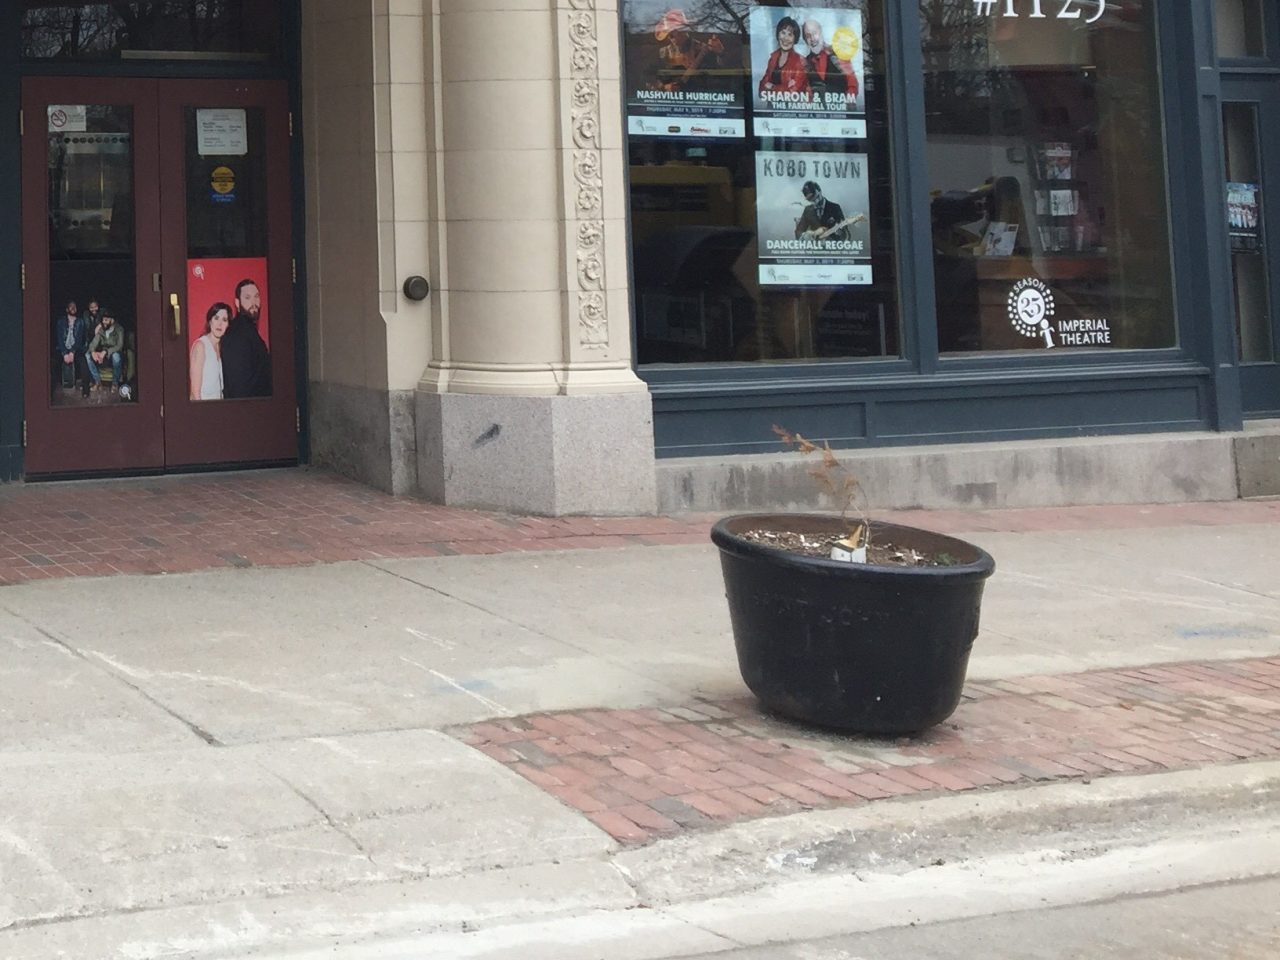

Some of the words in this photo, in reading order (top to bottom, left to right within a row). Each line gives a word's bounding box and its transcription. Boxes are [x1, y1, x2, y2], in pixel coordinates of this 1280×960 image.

[637, 90, 683, 100] NASHVILLE
[686, 91, 735, 102] HURRICANE
[761, 90, 809, 102] SHARON
[813, 92, 821, 103] &
[824, 92, 856, 104] BRAM
[772, 102, 786, 110] THE
[788, 102, 825, 110] FAREWELL
[826, 103, 847, 111] TOUR
[763, 159, 807, 178] KOBO
[812, 160, 861, 179] TOWN
[766, 240, 823, 250] DANCEHALL
[825, 240, 864, 250] REGGAE
[1013, 277, 1046, 294] SEASON
[1020, 297, 1042, 319] 25
[1058, 318, 1110, 332] IMPERIAL
[1060, 332, 1111, 345] THEATRE
